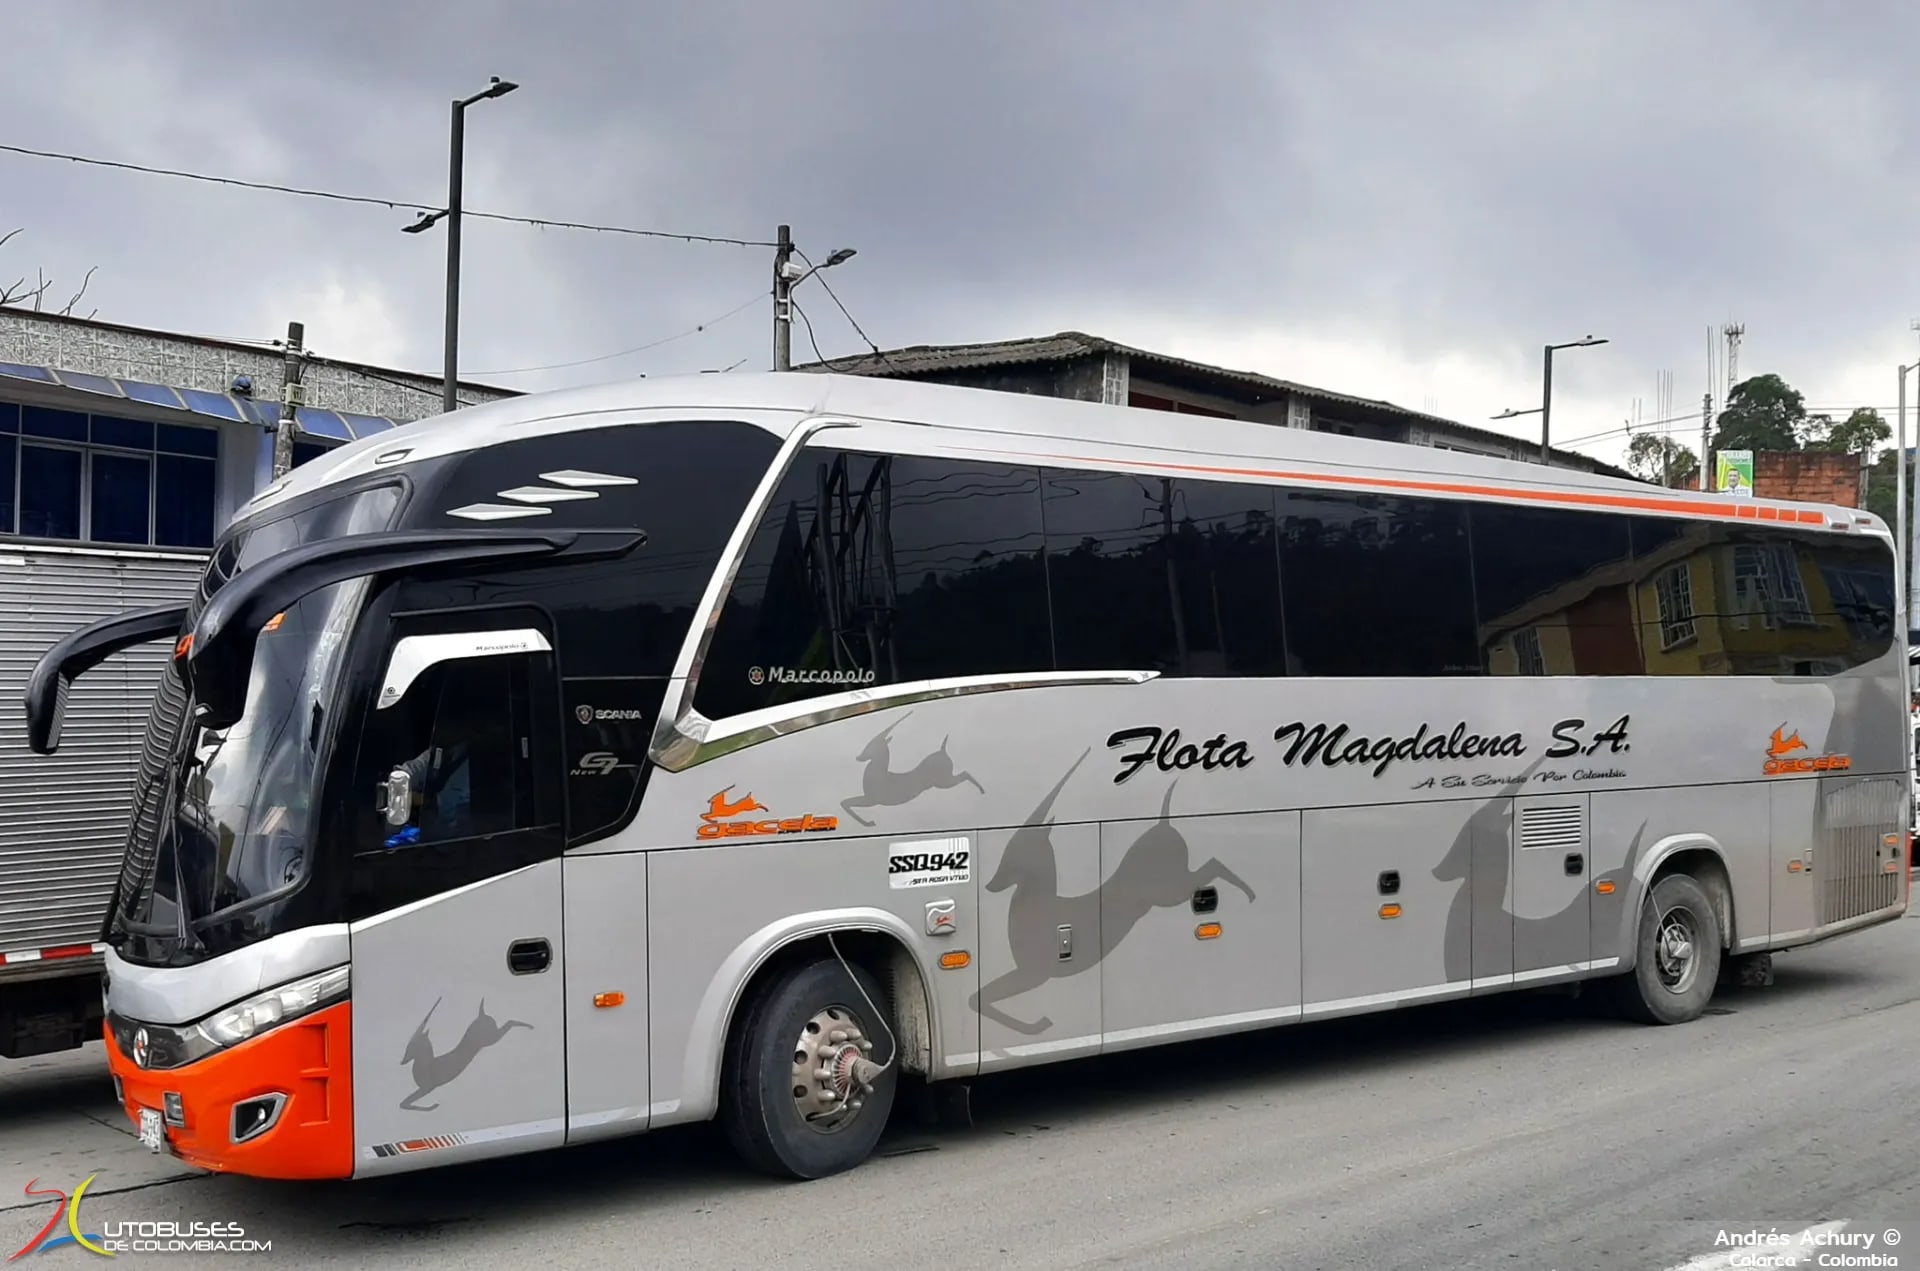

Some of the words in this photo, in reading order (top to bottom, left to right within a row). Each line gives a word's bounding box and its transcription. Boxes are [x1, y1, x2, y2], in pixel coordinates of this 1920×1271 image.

[768, 666, 876, 685] Marcopolo
[594, 709, 642, 720] SCANIA
[1106, 726, 1255, 784] Flota
[1273, 721, 1526, 777] Magdalena
[1545, 714, 1631, 759] S.A.
[1440, 775, 1467, 789] Su
[1471, 774, 1528, 787] Servicio
[1533, 770, 1568, 782] Por
[1572, 768, 1627, 781] Colombia
[696, 813, 840, 841] gacela
